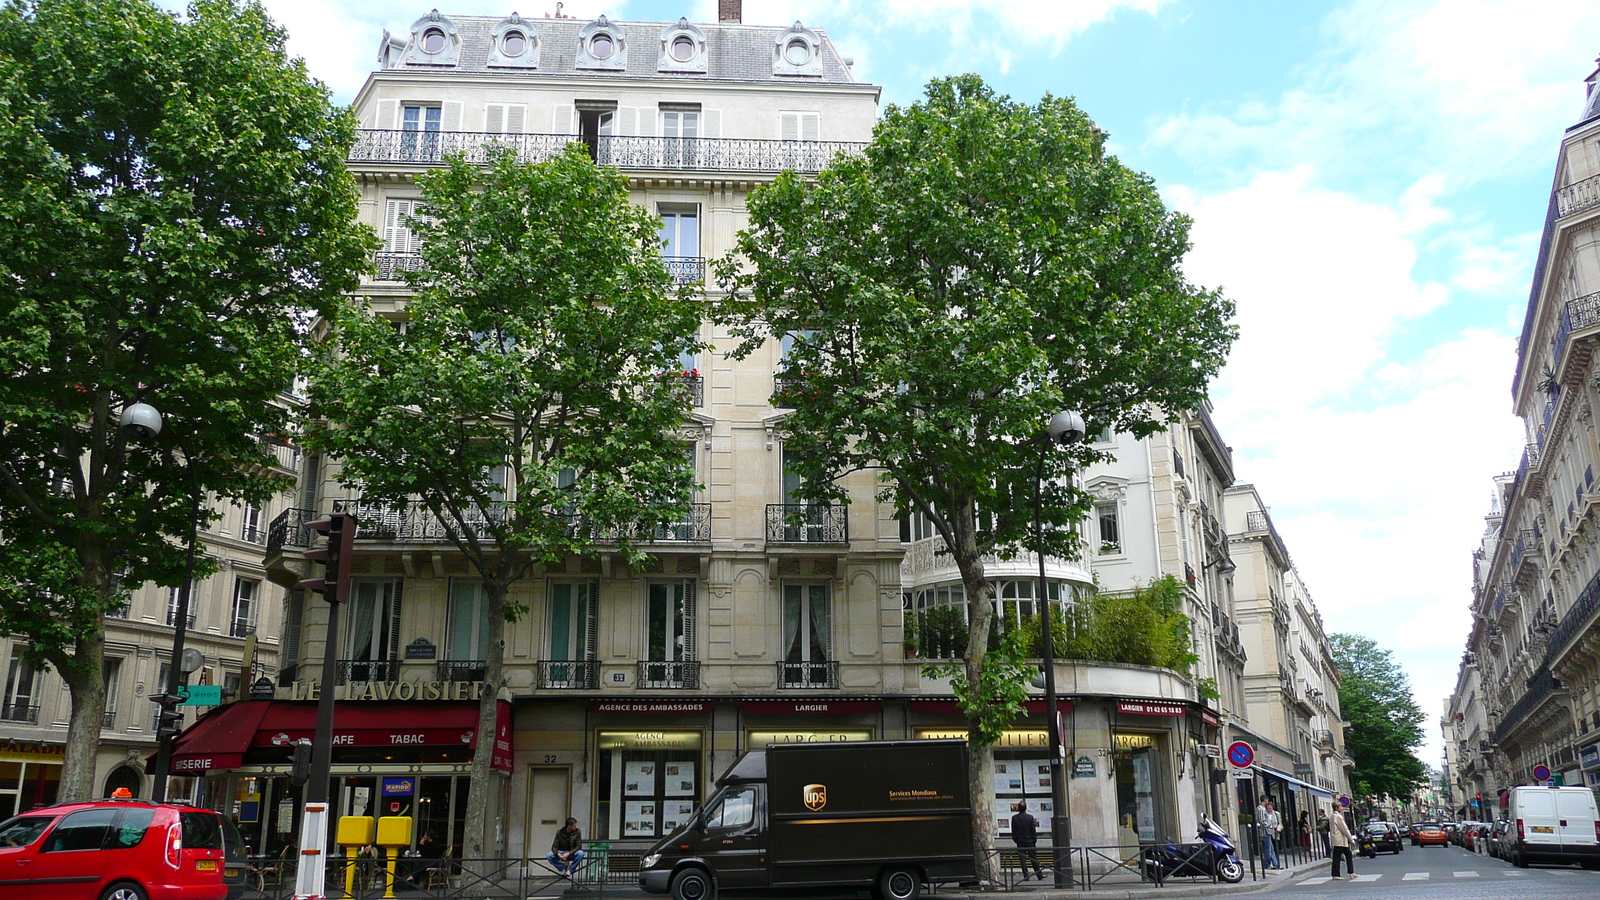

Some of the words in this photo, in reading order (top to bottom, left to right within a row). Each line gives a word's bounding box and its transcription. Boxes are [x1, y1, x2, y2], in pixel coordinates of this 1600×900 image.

[290, 681, 321, 700] LE
[649, 703, 703, 711] AMBASSADES
[795, 704, 829, 712] LARGIER
[1120, 704, 1144, 712] LARGIER
[1146, 705, 1153, 713] 01
[1153, 705, 1161, 713] 42
[332, 735, 355, 745] AFE
[390, 734, 425, 744] TABAC
[634, 732, 666, 740] AGENCE
[634, 740, 686, 748] AMBASSADES
[1098, 749, 1106, 757] 32
[544, 755, 557, 763] 32
[805, 791, 825, 807] ups
